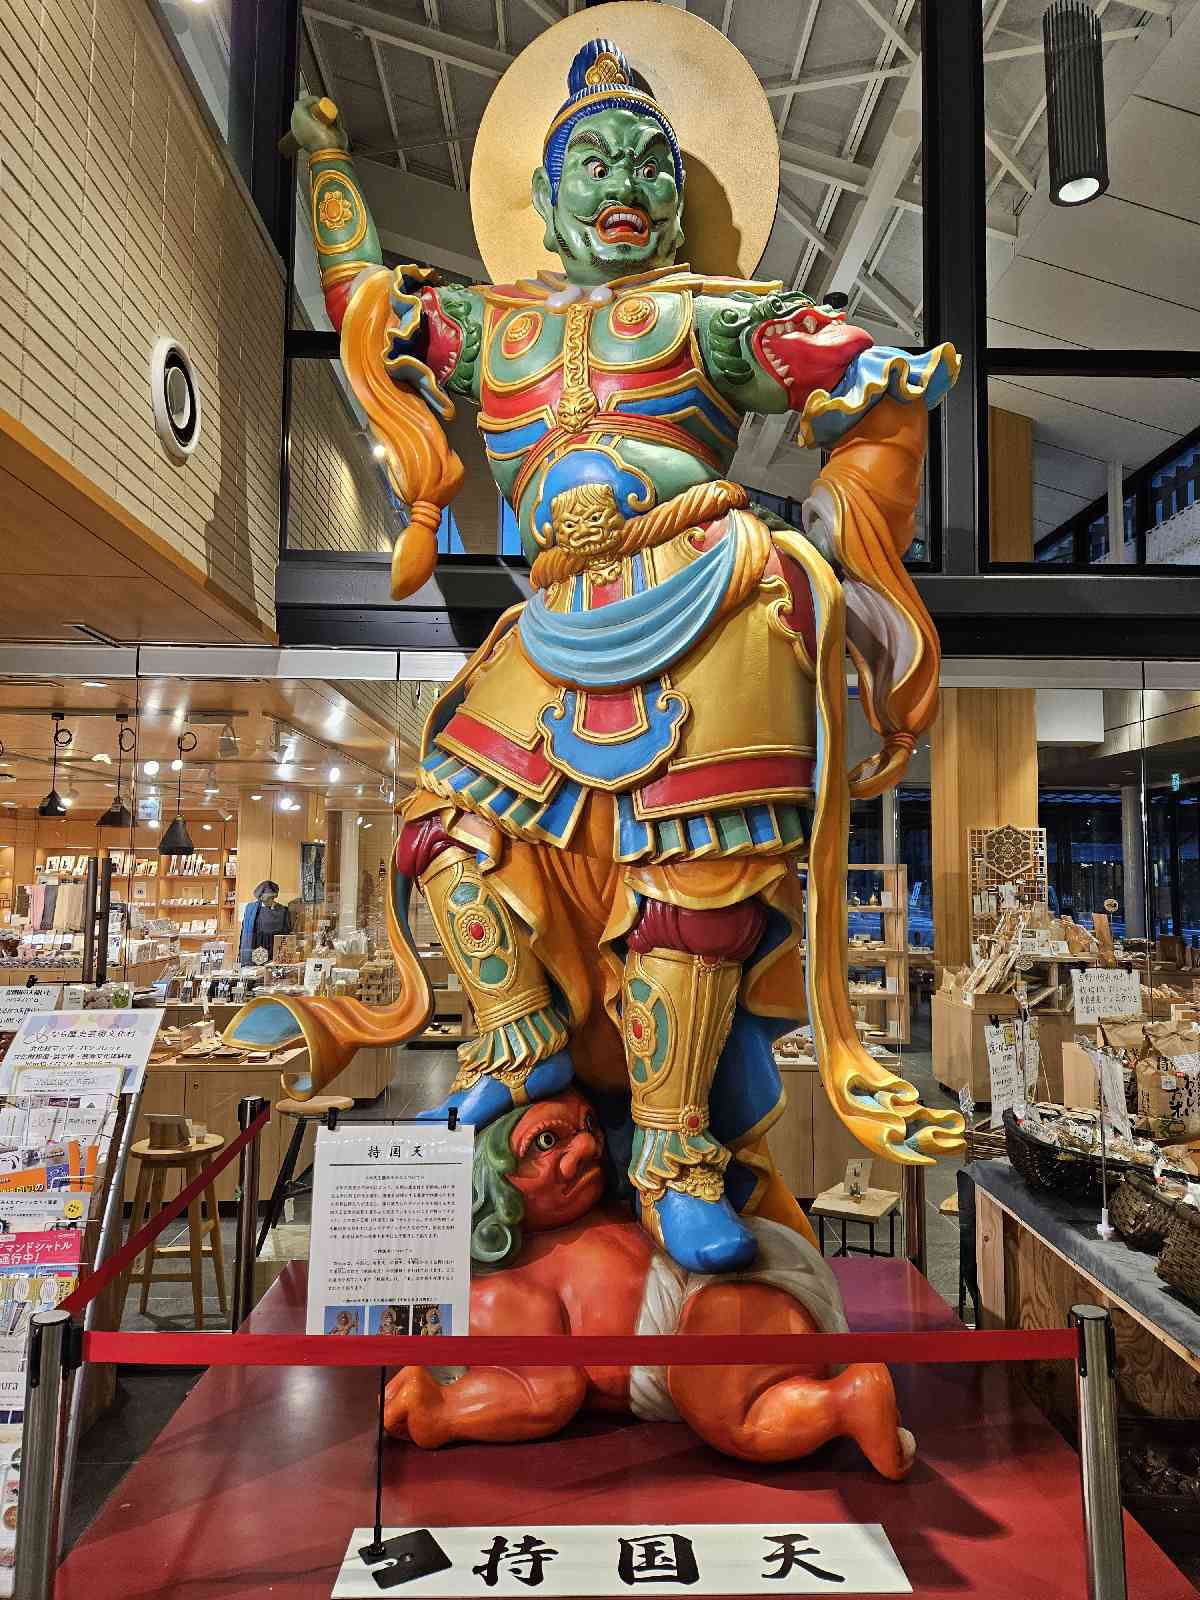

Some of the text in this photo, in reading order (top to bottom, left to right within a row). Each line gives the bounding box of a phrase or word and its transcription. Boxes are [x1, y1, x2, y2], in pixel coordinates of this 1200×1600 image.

[367, 1145, 425, 1158] 持国天
[472, 1533, 845, 1587] 持国天
